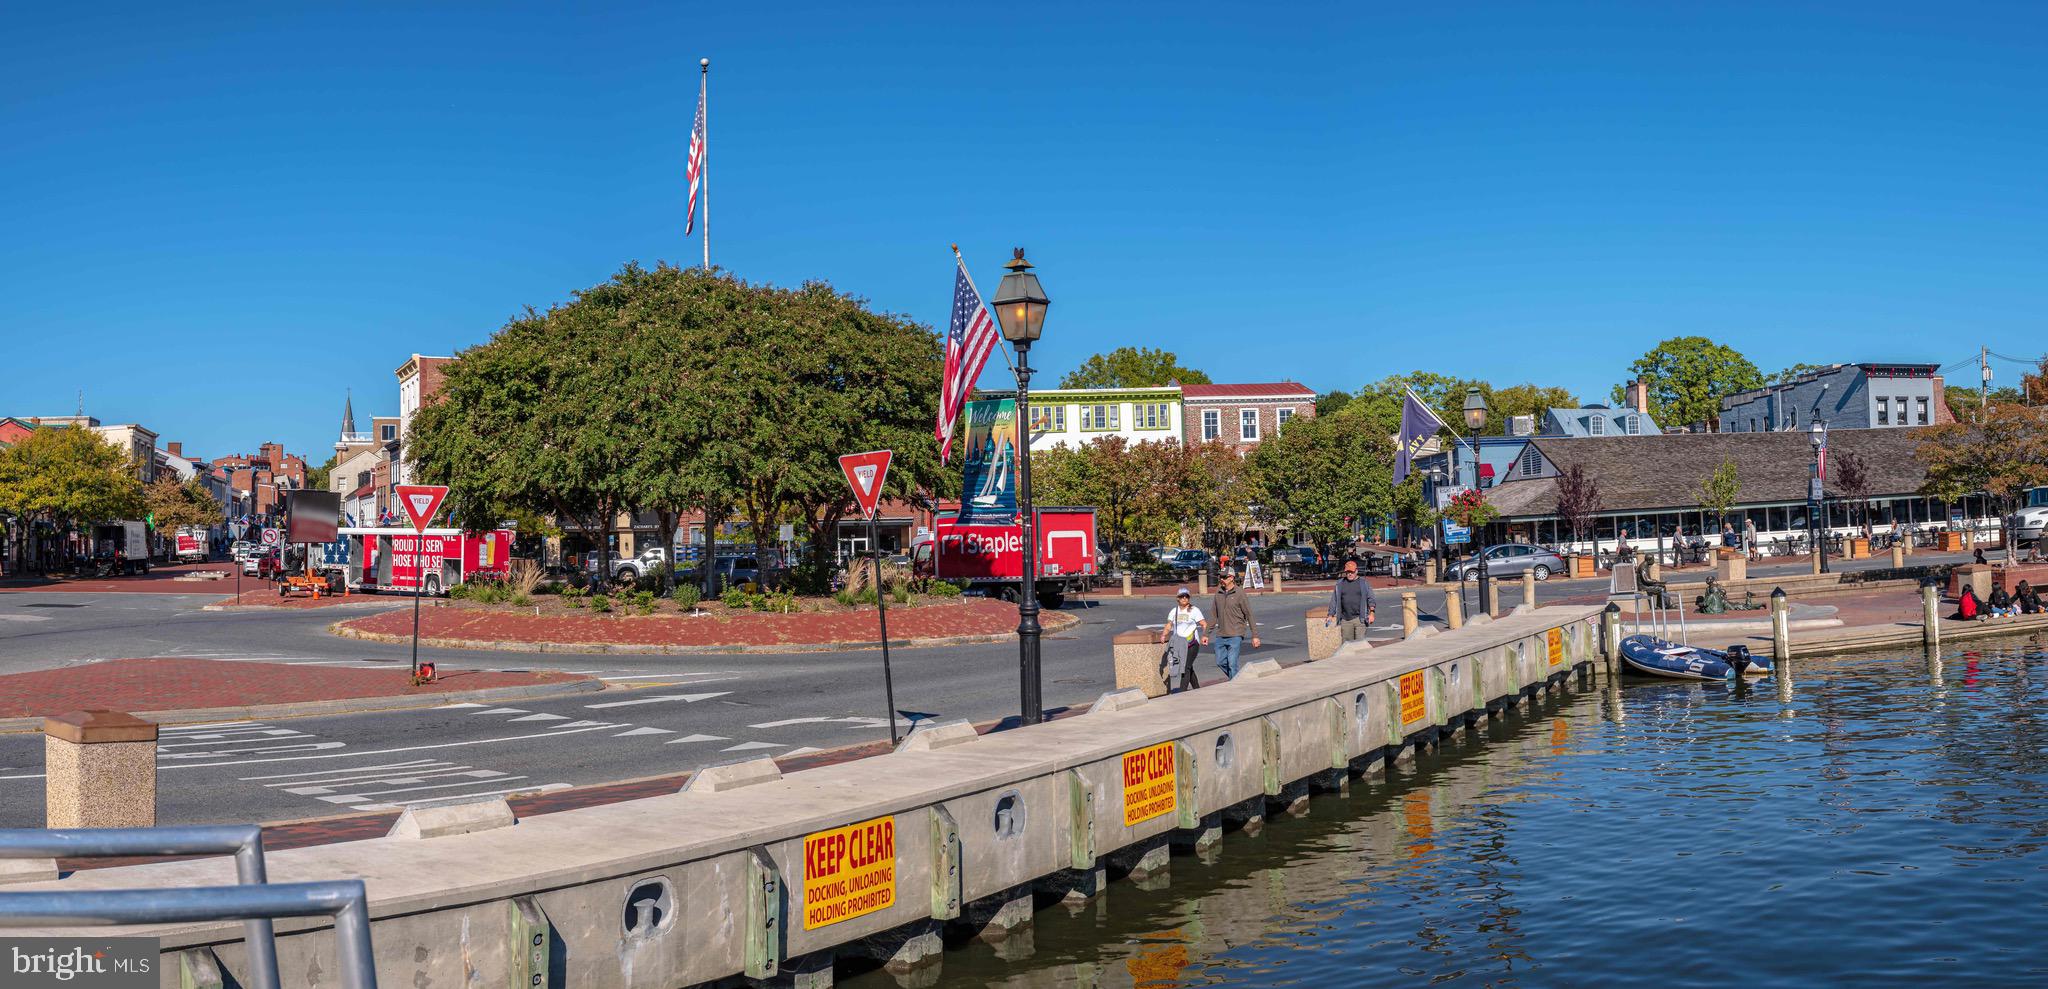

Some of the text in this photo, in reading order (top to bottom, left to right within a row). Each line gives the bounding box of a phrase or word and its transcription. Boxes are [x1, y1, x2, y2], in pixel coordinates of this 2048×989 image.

[969, 404, 1013, 424] Welcome
[858, 469, 873, 478] YIELD
[1123, 745, 1174, 788] KEEP CLEAR
[1148, 780, 1174, 799] UNLOADING
[1127, 796, 1174, 822] HOLDING PROHIBITED
[806, 821, 893, 880] KEEP CLEAR
[808, 867, 892, 904] DOCKING, UNLOADING
[809, 888, 891, 925] HOLDING PROHIBITED
